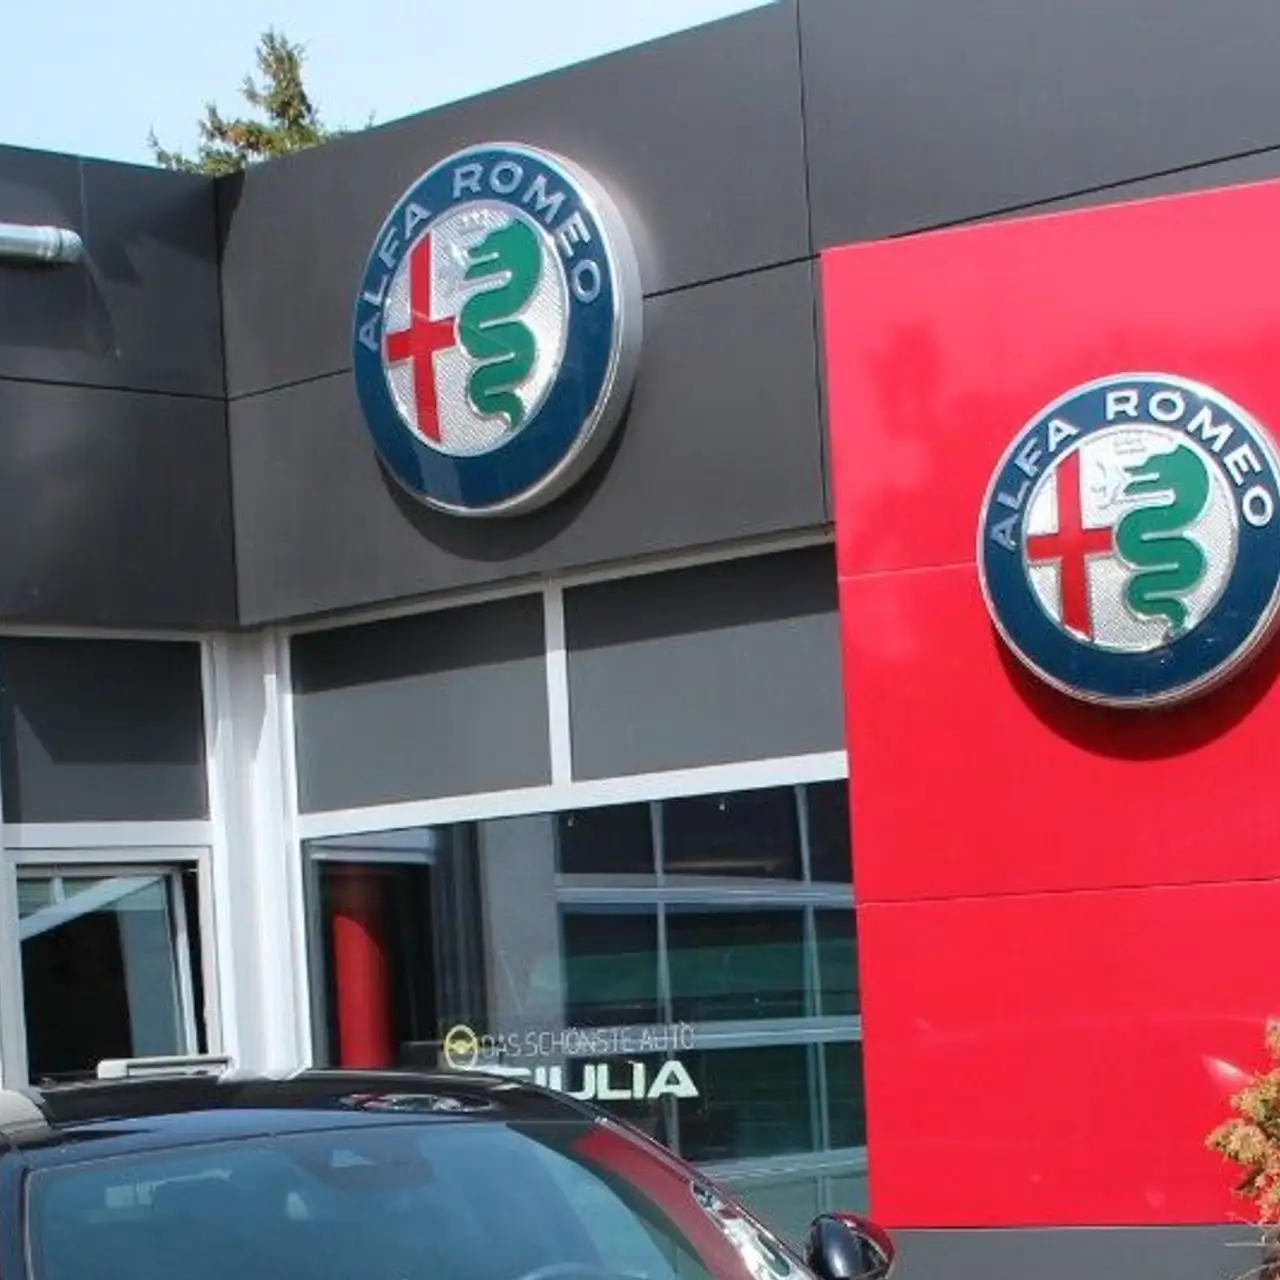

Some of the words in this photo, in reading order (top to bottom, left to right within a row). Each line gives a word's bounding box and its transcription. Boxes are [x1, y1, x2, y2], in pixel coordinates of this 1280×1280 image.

[358, 202, 431, 352] ALFA
[452, 160, 601, 303] ROMEO
[991, 418, 1080, 551] ALFA
[1105, 389, 1273, 528] ROMEO
[477, 1060, 700, 1100] IULIA
